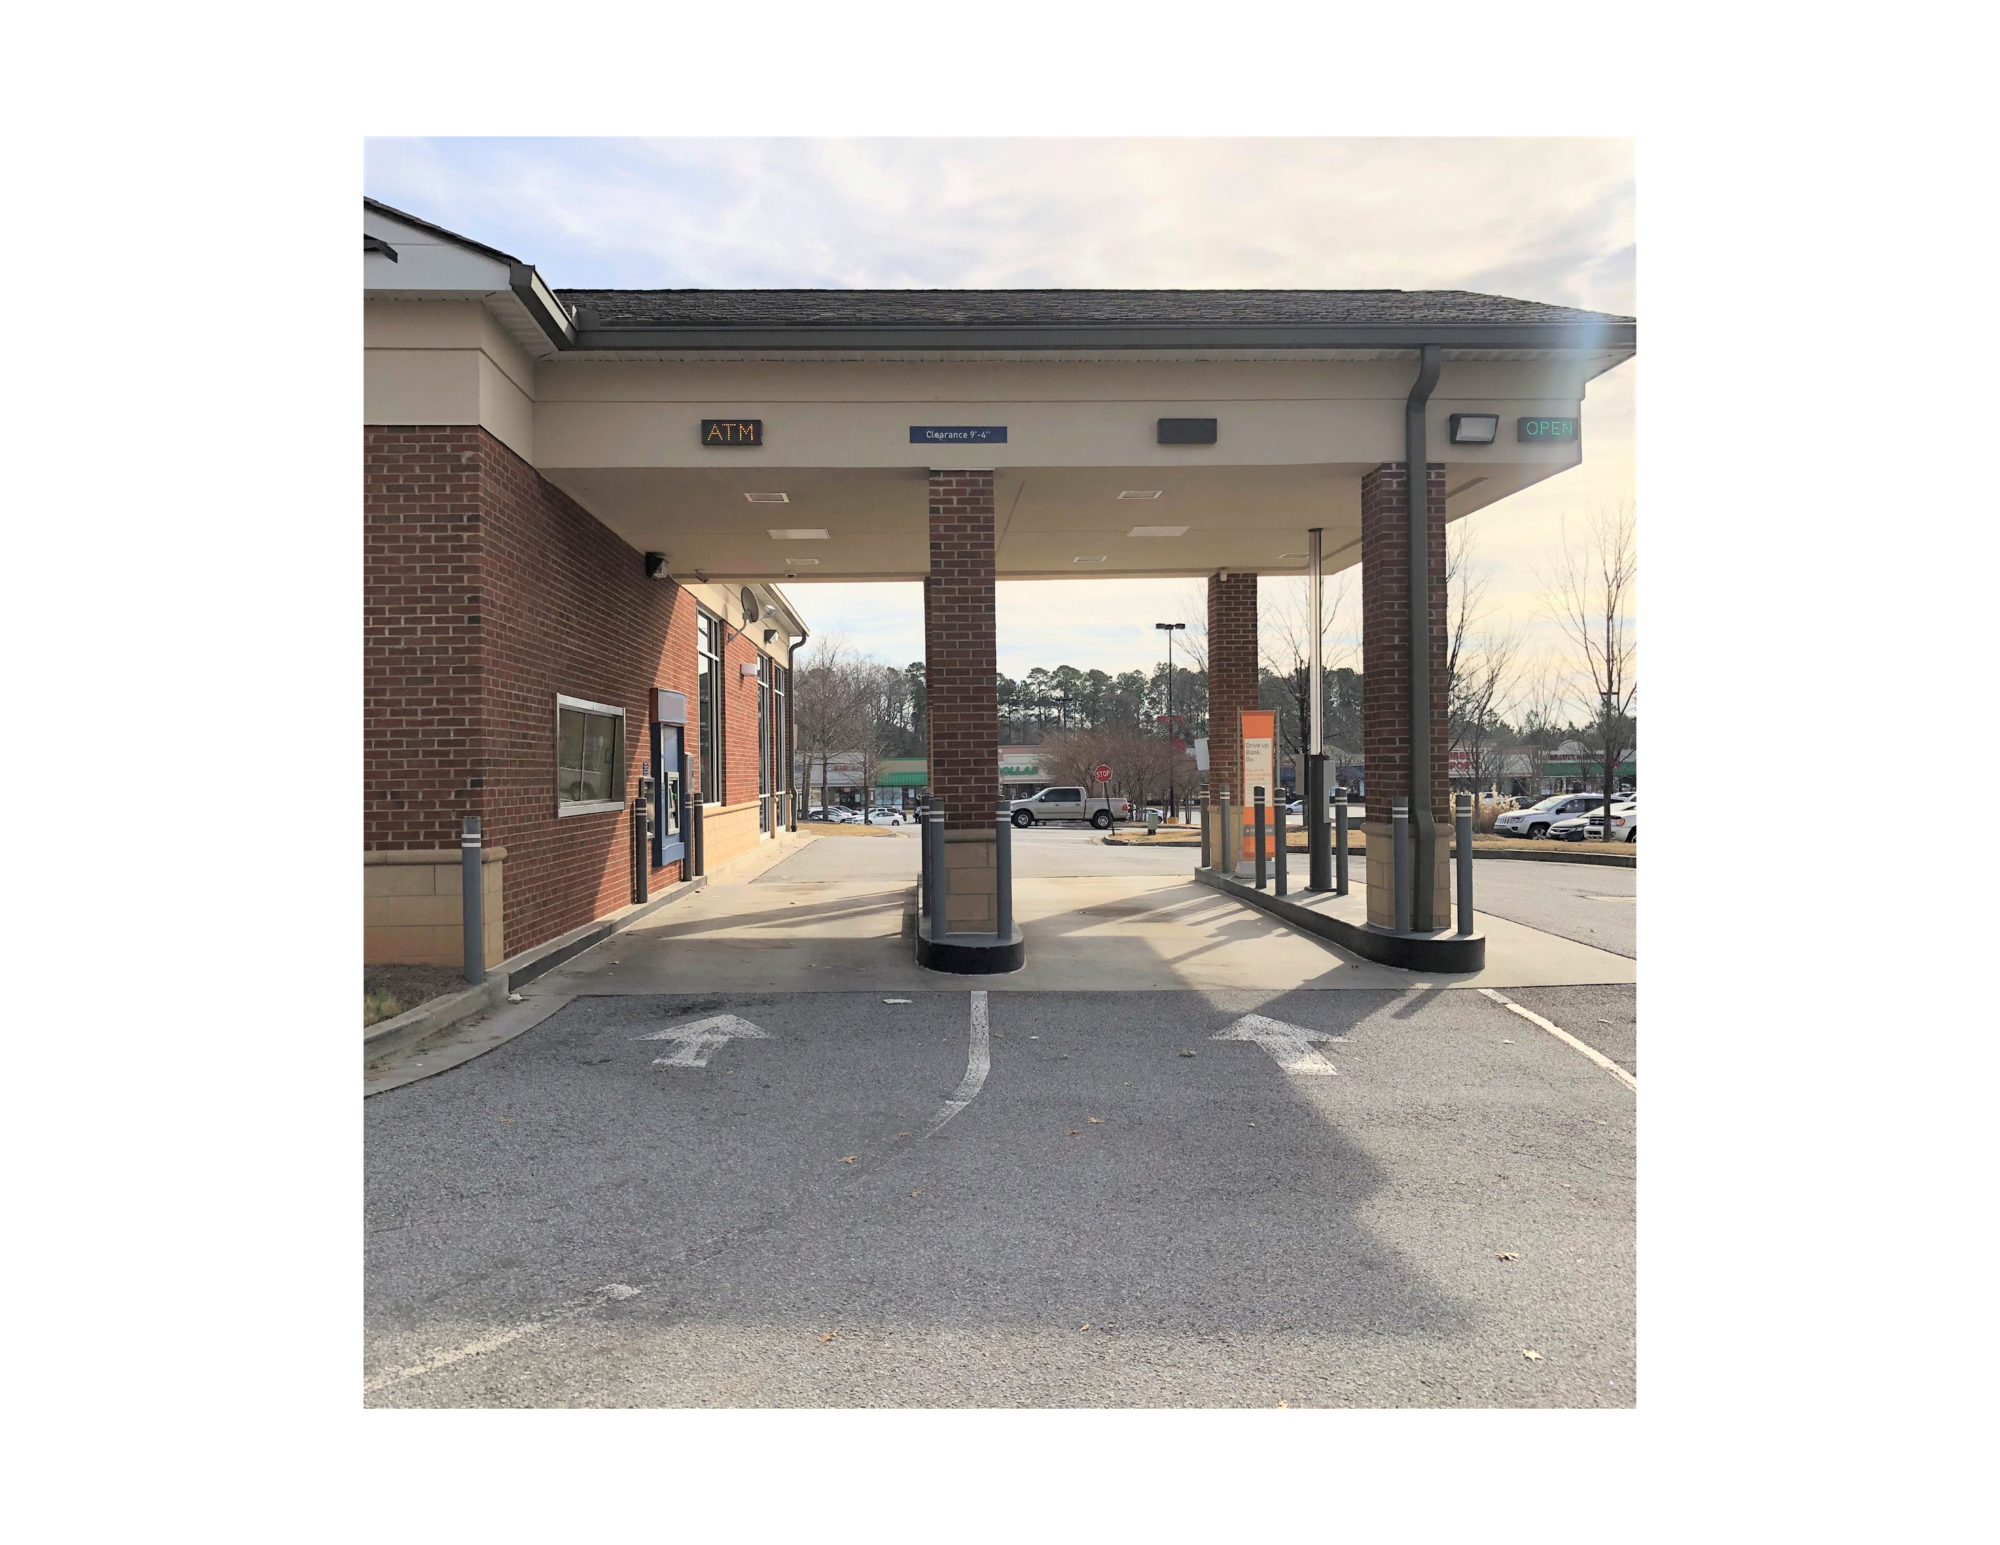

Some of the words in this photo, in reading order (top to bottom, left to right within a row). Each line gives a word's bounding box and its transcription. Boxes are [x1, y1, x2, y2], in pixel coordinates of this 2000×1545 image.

[707, 423, 754, 441] ATM
[1526, 420, 1573, 436] OPEN
[926, 430, 968, 439] Clearance
[1096, 770, 1110, 778] STOP
